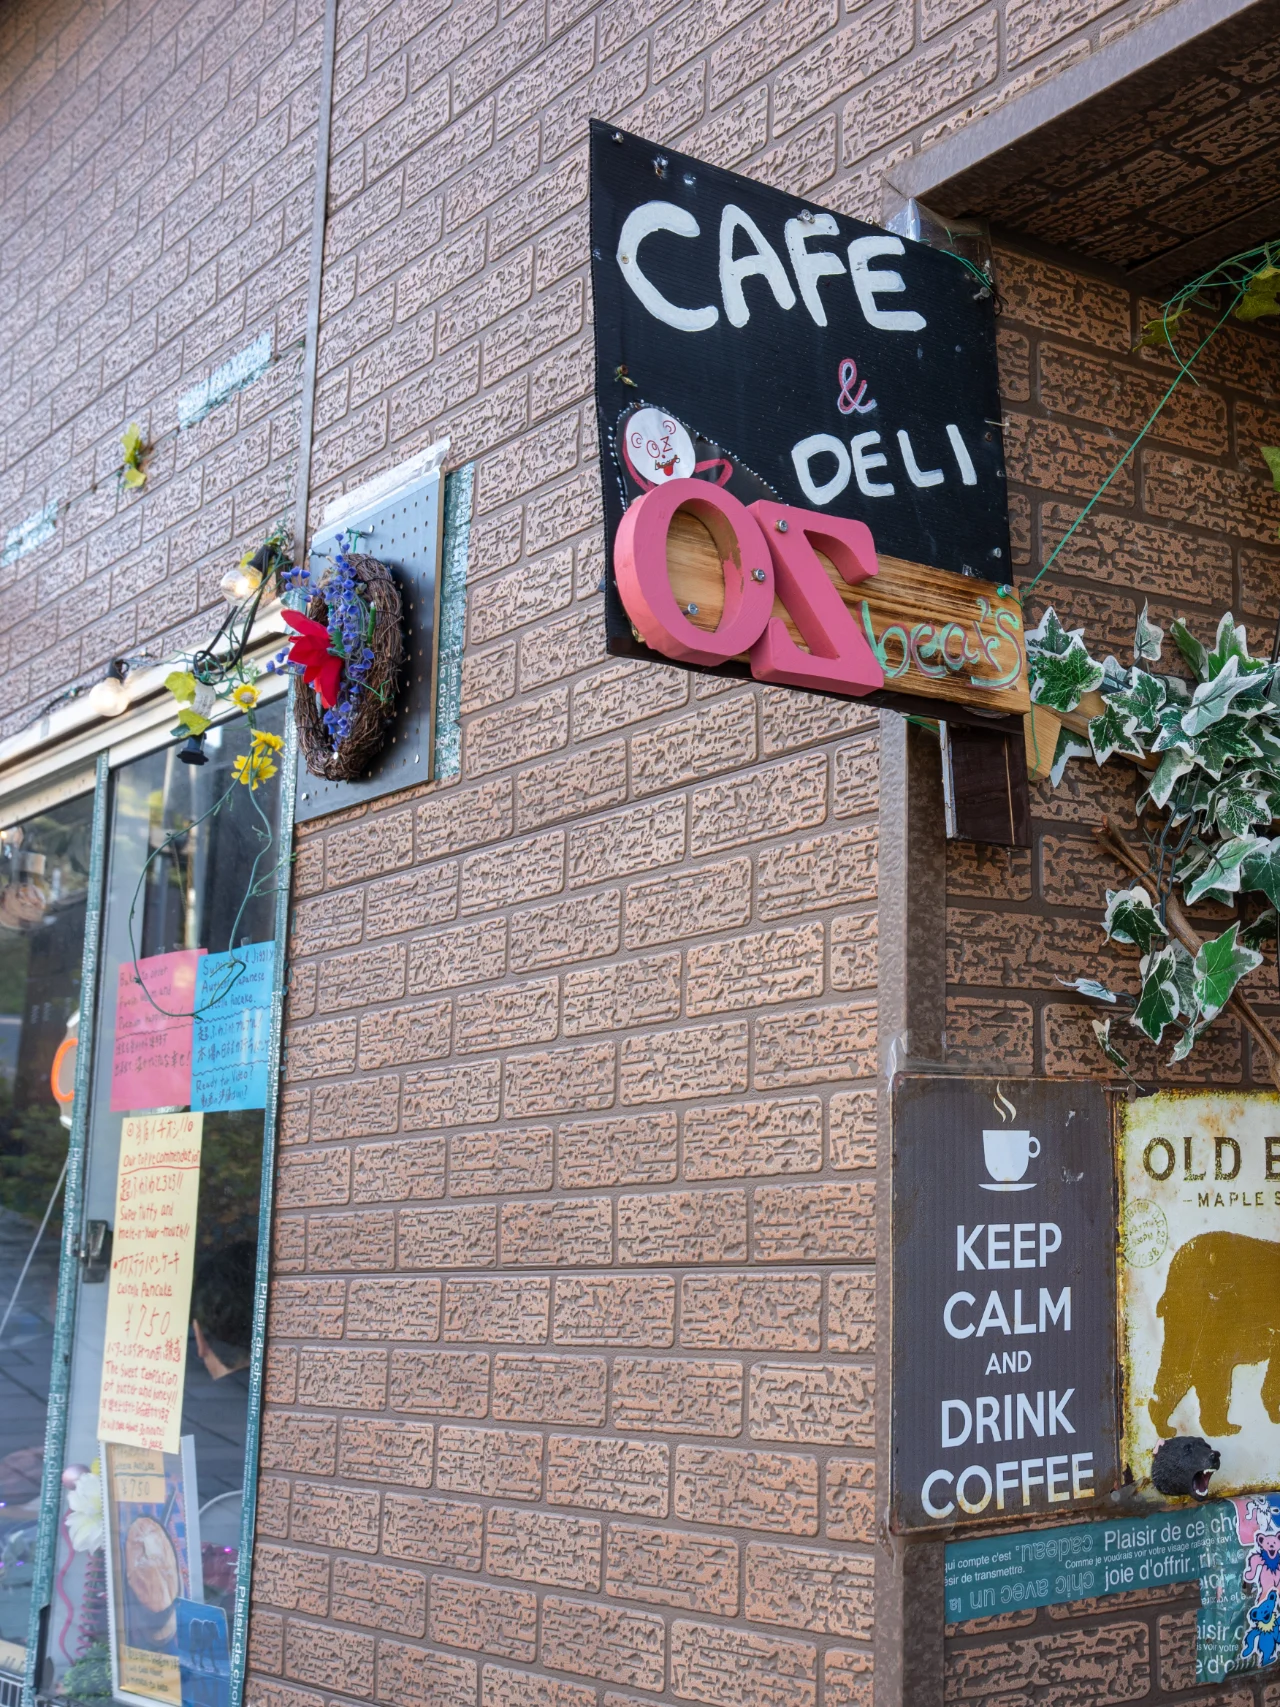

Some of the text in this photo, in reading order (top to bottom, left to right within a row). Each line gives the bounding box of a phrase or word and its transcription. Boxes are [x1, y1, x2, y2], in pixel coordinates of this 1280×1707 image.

[616, 200, 927, 332] CAFE
[837, 358, 878, 416] &
[791, 424, 977, 504] DELI
[613, 477, 884, 696] OZ
[1142, 1136, 1242, 1182] OLD
[1197, 1191, 1264, 1208] MAPLE
[956, 1222, 1063, 1271] KEEP
[943, 1286, 1072, 1339] CALM
[985, 1350, 1032, 1375] AND
[941, 1388, 1076, 1449] DRINK
[921, 1452, 1095, 1519] COFFEE
[958, 1555, 990, 1569] compte
[992, 1550, 1012, 1563] c'est
[1065, 1558, 1094, 1569] Comme
[1095, 1555, 1102, 1567] je
[1103, 1551, 1133, 1563] voudrais
[1134, 1549, 1148, 1558] voir
[1149, 1547, 1166, 1556] votre
[1168, 1543, 1190, 1554] visage
[1104, 1526, 1156, 1551] Plaisir
[1161, 1523, 1181, 1543] de
[961, 1574, 972, 1584] de
[975, 1564, 1026, 1581] transmettre.
[1104, 1555, 1195, 1592] joie d'offrir.
